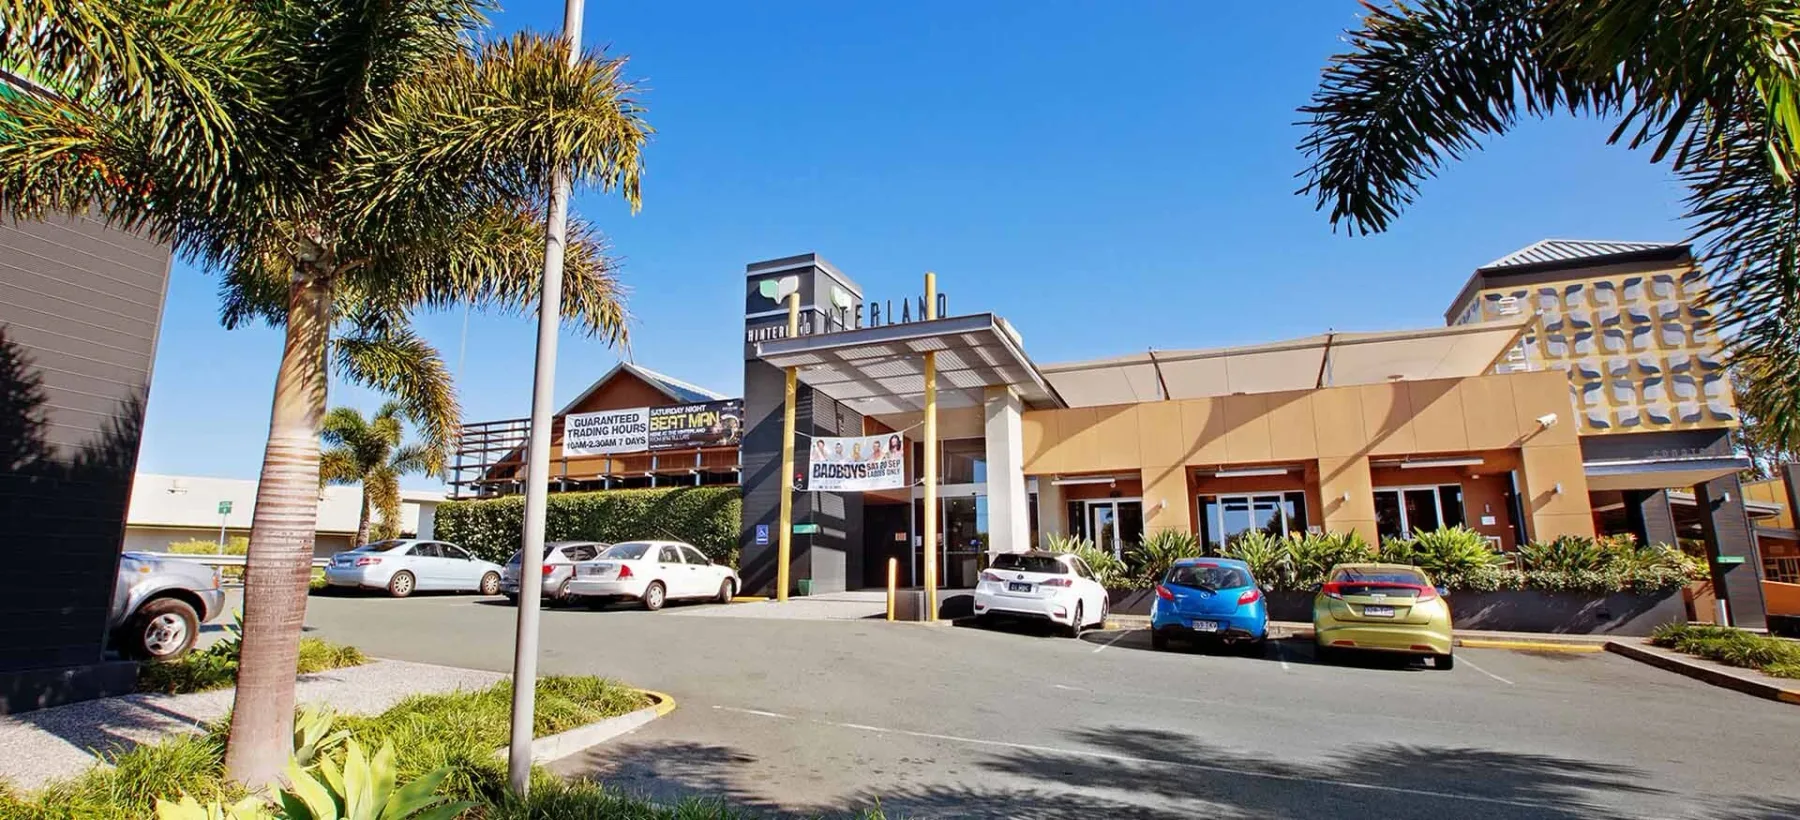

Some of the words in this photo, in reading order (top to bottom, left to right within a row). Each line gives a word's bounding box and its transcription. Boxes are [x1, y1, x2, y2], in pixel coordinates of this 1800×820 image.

[651, 407, 684, 416] SATURDAY
[685, 405, 706, 413] NIGHT
[574, 413, 639, 428] GUARANTEED
[650, 414, 687, 431] BEAT
[688, 411, 719, 428] MAN
[567, 427, 609, 438] TRADING
[611, 423, 646, 435] HOURS
[567, 439, 617, 450] 10AM-2.30AM
[619, 438, 623, 446] 7
[625, 436, 646, 446] DAYS
[813, 463, 867, 479] BADBOYS
[867, 462, 879, 471] SAT
[888, 460, 901, 469] SEP
[887, 468, 900, 476] ONLY
